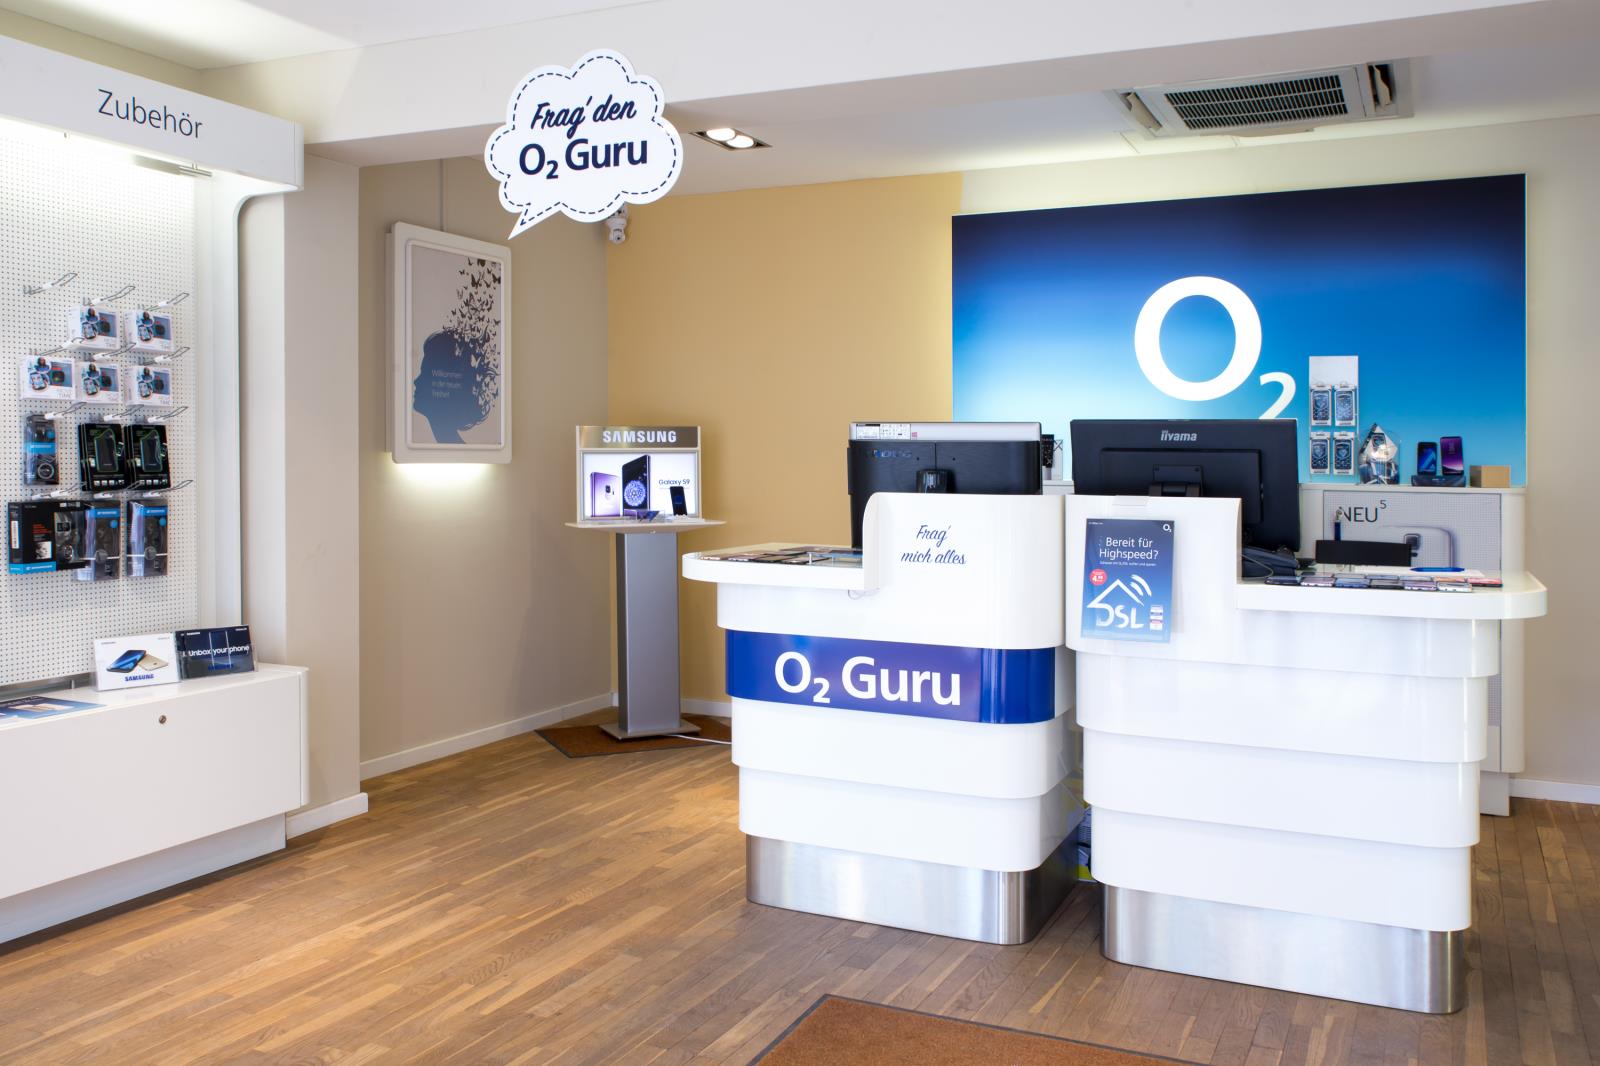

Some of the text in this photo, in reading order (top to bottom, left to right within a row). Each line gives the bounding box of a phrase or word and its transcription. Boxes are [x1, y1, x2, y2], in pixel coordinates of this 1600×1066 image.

[97, 88, 203, 139] Zubehör
[565, 138, 648, 171] Guru
[602, 430, 677, 443] SAMSUNG
[1160, 429, 1198, 443] iiyama
[658, 478, 682, 487] Galaxy
[1105, 537, 1153, 548] Bereit für
[900, 547, 968, 565] mich alles
[1099, 548, 1159, 561] Highspeed?
[188, 644, 250, 657] Unbox your phone
[124, 673, 155, 682] SAMSUNG
[841, 655, 961, 706] Guru
